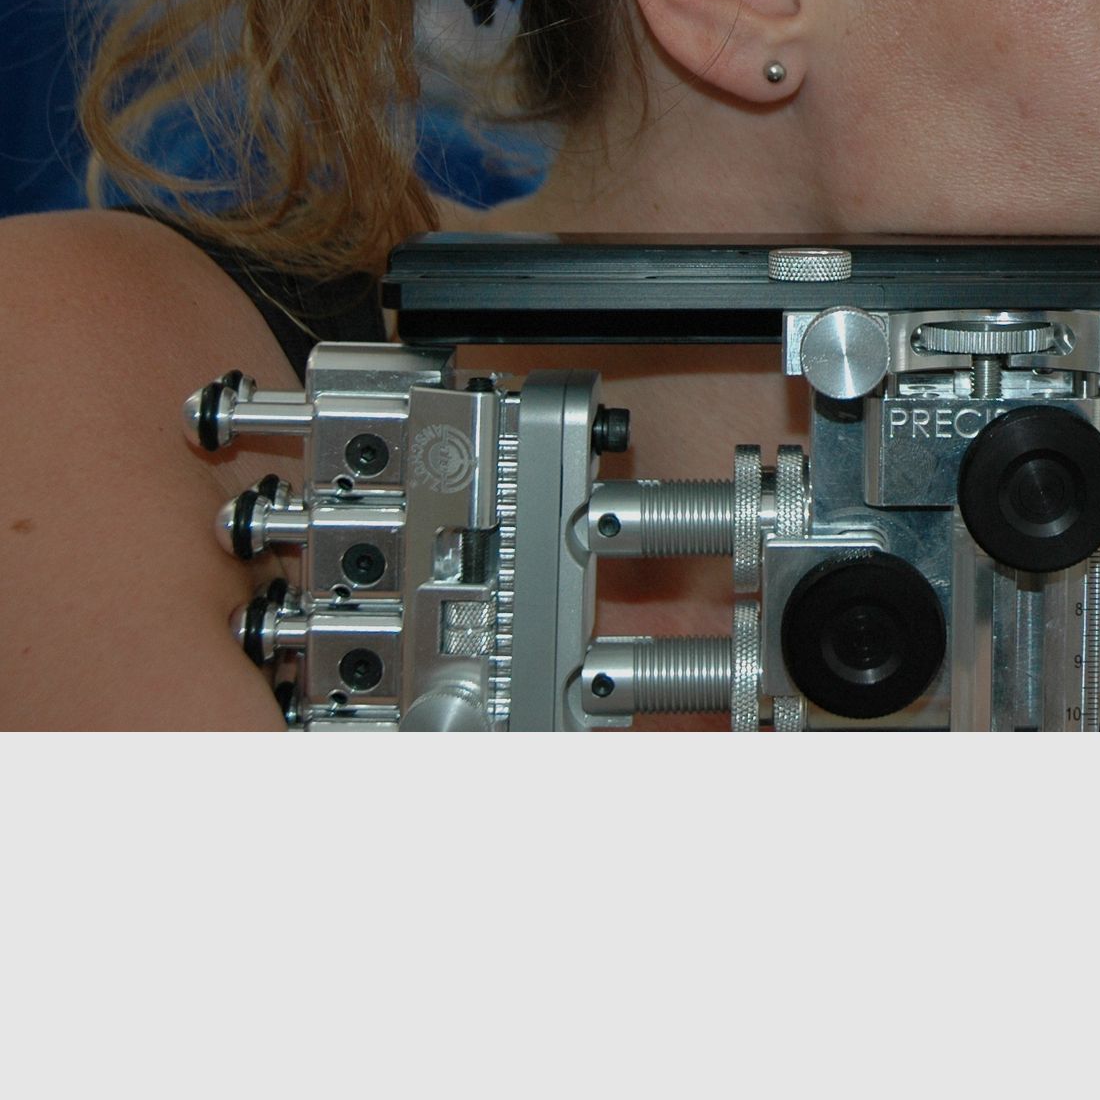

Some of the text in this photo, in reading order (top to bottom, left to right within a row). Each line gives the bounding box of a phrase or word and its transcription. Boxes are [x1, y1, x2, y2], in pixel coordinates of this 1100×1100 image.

[889, 408, 1008, 439] PRECI
[1075, 602, 1083, 617] 8
[1074, 654, 1083, 669] 9
[1066, 707, 1082, 722] 10
